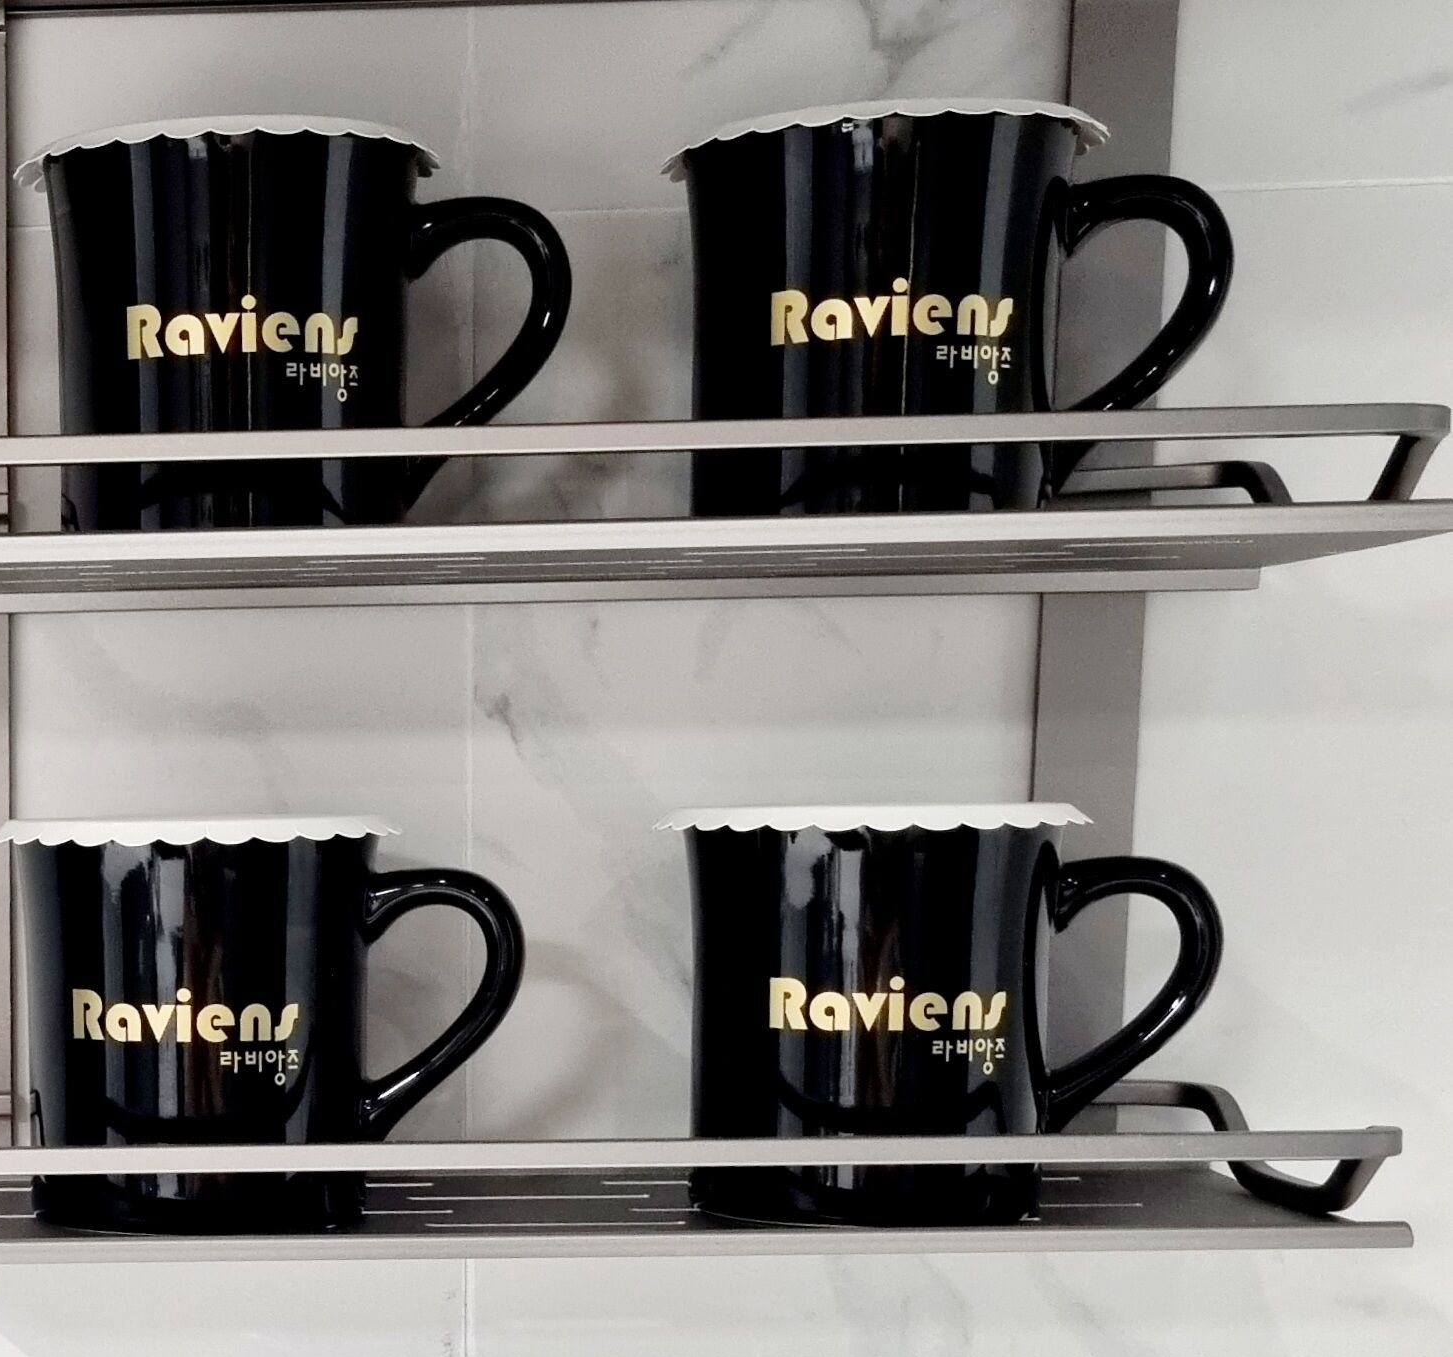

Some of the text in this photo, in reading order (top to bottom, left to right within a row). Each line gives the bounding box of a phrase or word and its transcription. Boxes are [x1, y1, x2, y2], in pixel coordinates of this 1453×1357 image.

[126, 294, 358, 360] Raviens
[771, 277, 1013, 346] Raviens
[286, 362, 358, 401] 라비앙즈
[936, 345, 1011, 384] 라비앙즈
[72, 988, 298, 1043] Raviens
[769, 976, 1006, 1031] Raviens
[220, 1049, 298, 1086] 라비앙즈
[932, 1038, 1005, 1075] 라비앙즈
